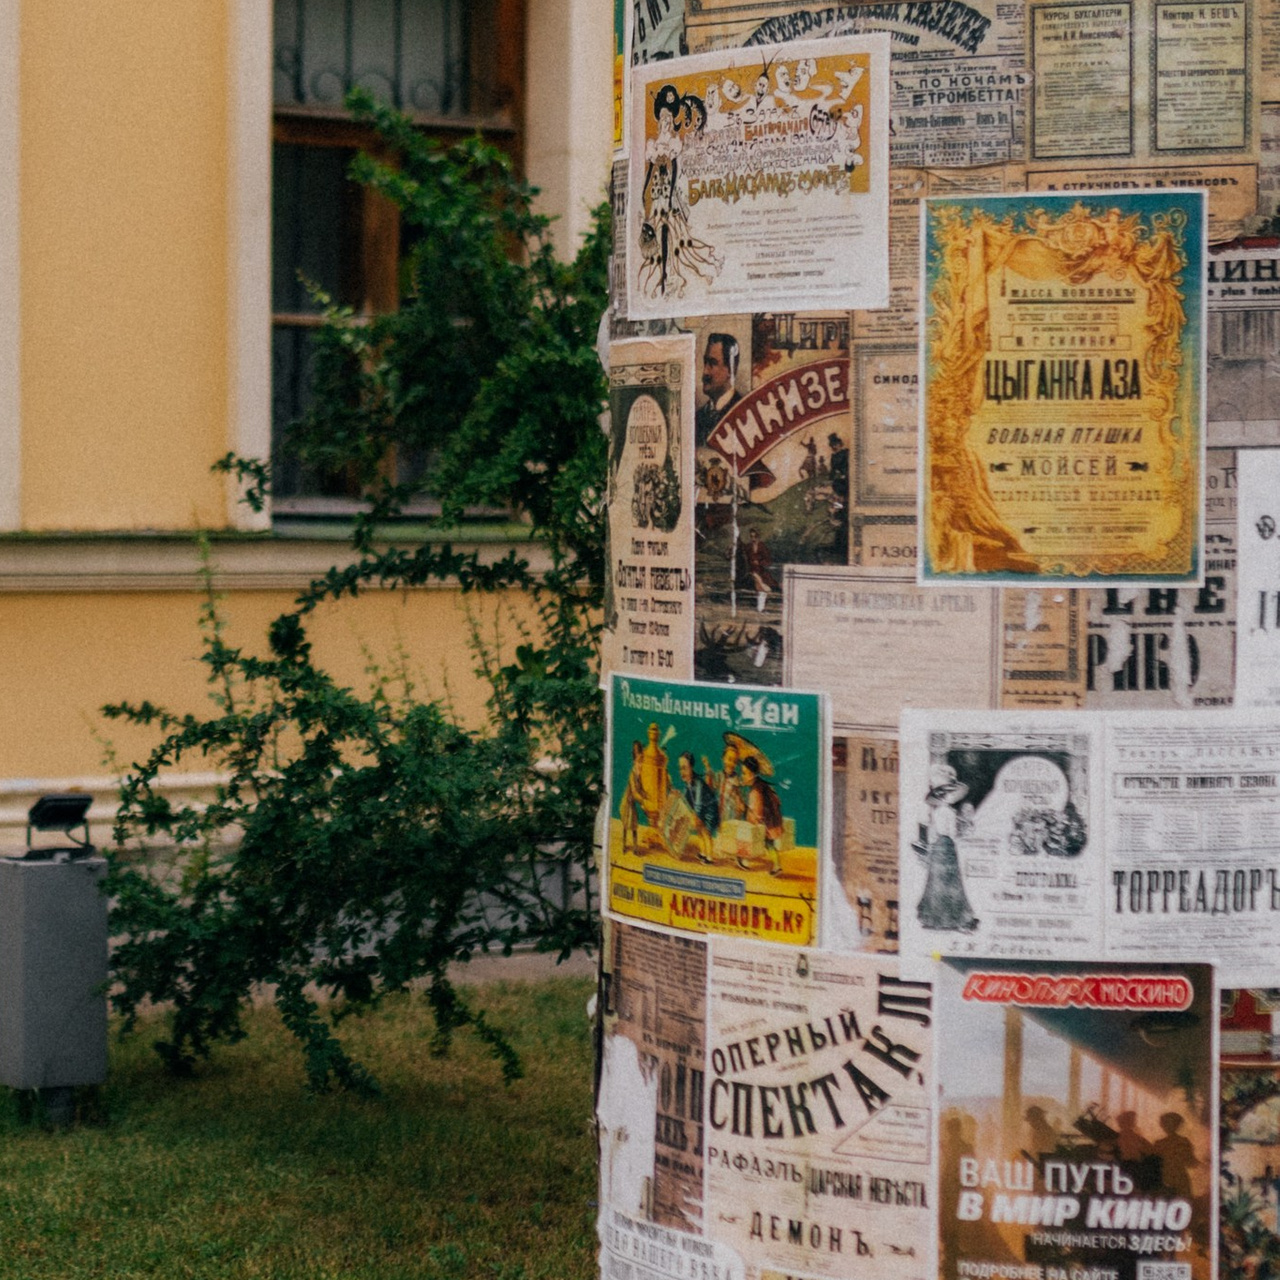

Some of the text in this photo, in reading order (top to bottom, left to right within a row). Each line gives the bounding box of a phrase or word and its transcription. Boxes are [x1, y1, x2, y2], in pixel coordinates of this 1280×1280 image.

[1043, 11, 1070, 21] КУРСЫ
[1162, 9, 1194, 21] Контора
[920, 78, 941, 89] ПО
[950, 75, 1025, 87] НОЧАМЪ
[1063, 181, 1140, 191] СТРУЧКОВЪ
[1171, 177, 1239, 188] ЧИБИСОВЪ
[1011, 288, 1053, 297] МАССА
[1221, 286, 1246, 298] plus
[986, 359, 1142, 405] ЦЫГАНКА АЗА
[715, 366, 850, 459] ЧИНИЗЕ
[987, 427, 1143, 444] ВОЛЬНАЯ ПТАШКА
[1240, 775, 1277, 788] СЕЗОНА
[1113, 868, 1280, 916] ТОРРЕАДОРЪ
[969, 975, 1187, 1005] КИНОПАРК МОСКИНО
[711, 1008, 862, 1076] ОПЕРНЫЙ
[708, 1146, 803, 1183] РАФАЭЛЬ
[960, 1157, 1134, 1195] ВАШ ПУТЬ
[810, 1168, 862, 1200] ЦАРСКАЯ
[957, 1191, 1193, 1231] В МИР КИНО
[1032, 1232, 1192, 1254] НАЧИНАЕТСЯ ЗДЕСЬ!
